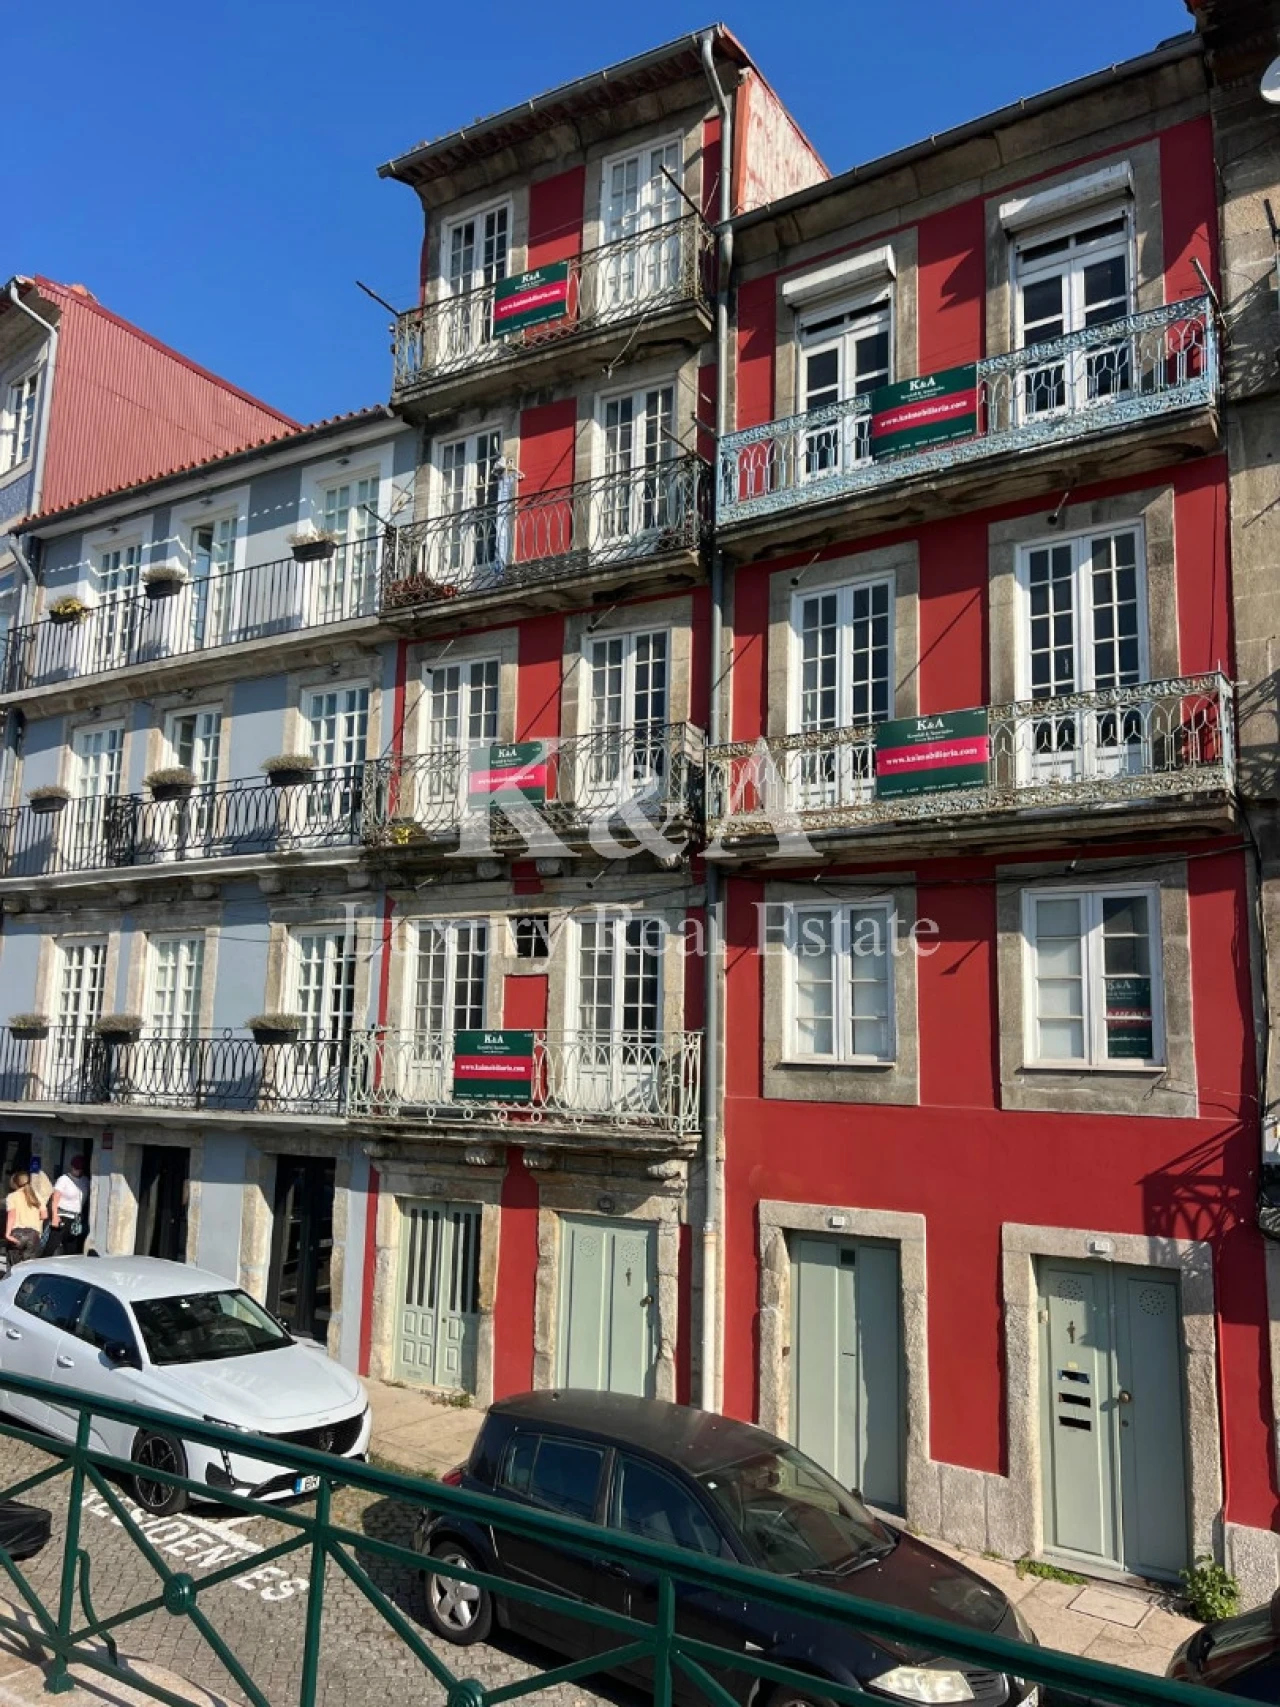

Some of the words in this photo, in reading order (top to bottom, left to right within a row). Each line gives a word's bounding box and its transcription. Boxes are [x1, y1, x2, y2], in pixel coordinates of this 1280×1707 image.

[909, 375, 936, 391] K&A
[916, 717, 945, 731] K&A
[886, 747, 978, 766] www.kaimobiliaria.com
